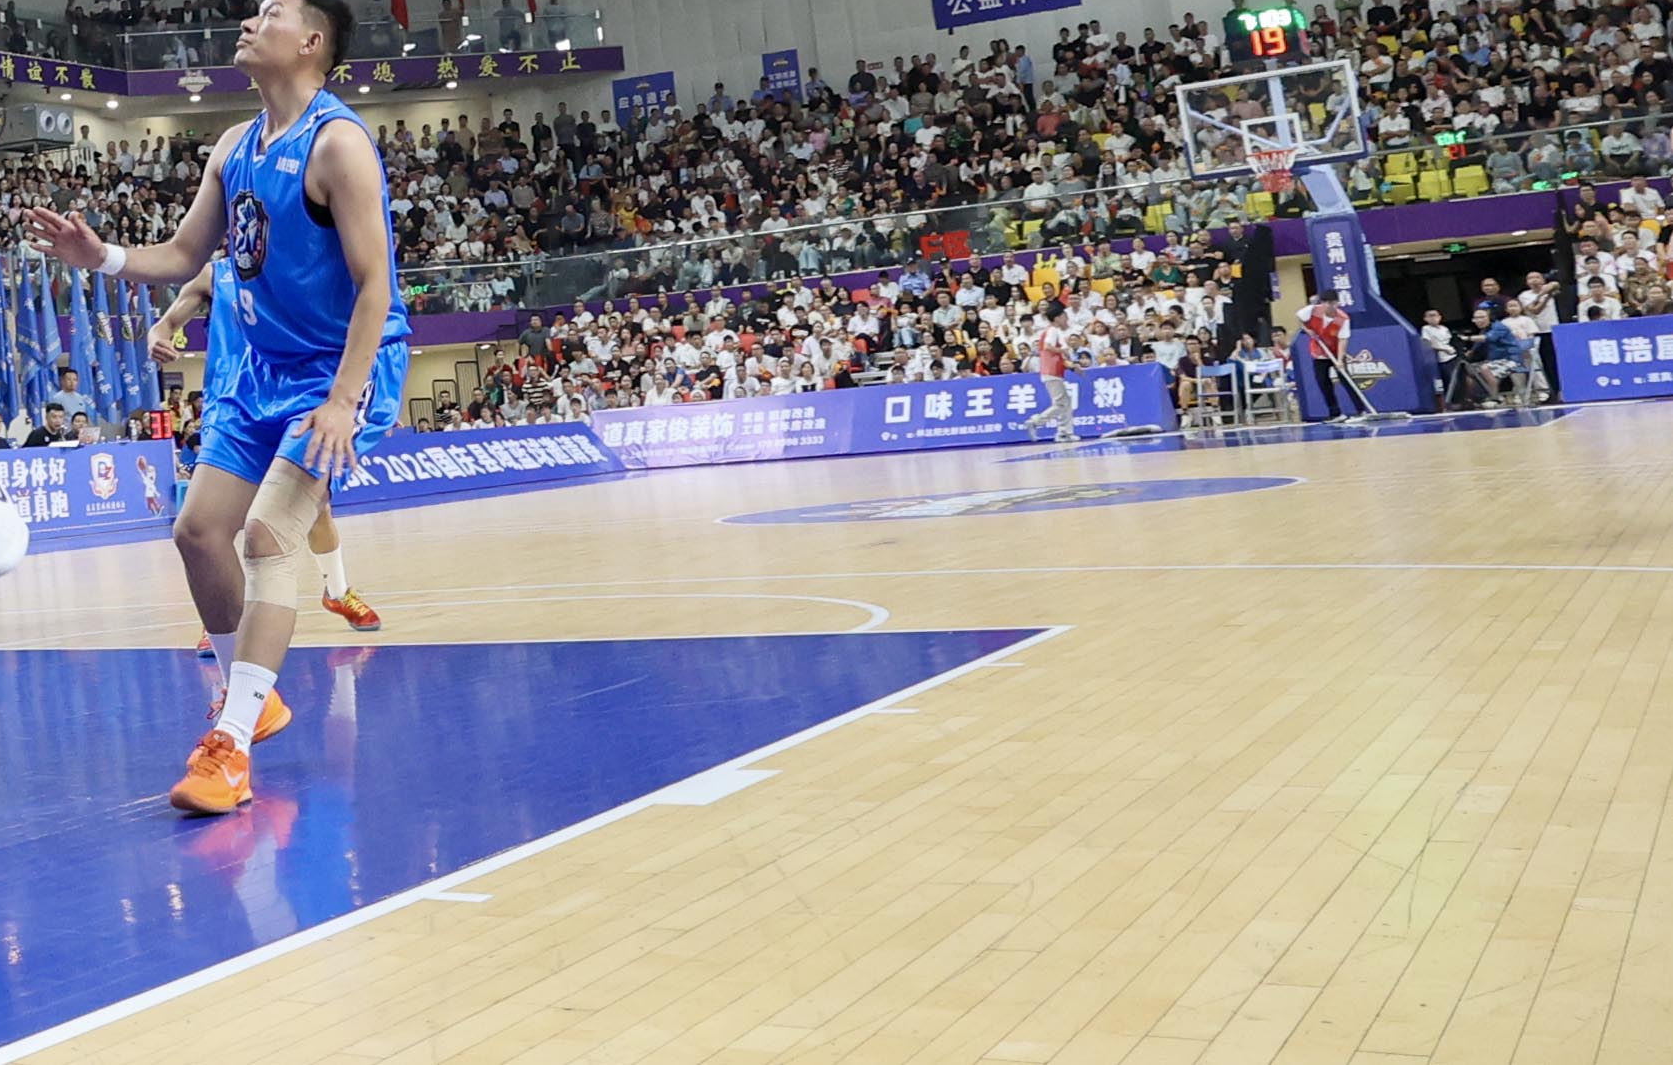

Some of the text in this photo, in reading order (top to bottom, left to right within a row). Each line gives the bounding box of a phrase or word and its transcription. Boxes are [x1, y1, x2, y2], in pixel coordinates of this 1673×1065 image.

[1250, 27, 1287, 56] 19
[438, 52, 582, 81] 热爱不止
[239, 288, 258, 326] 9
